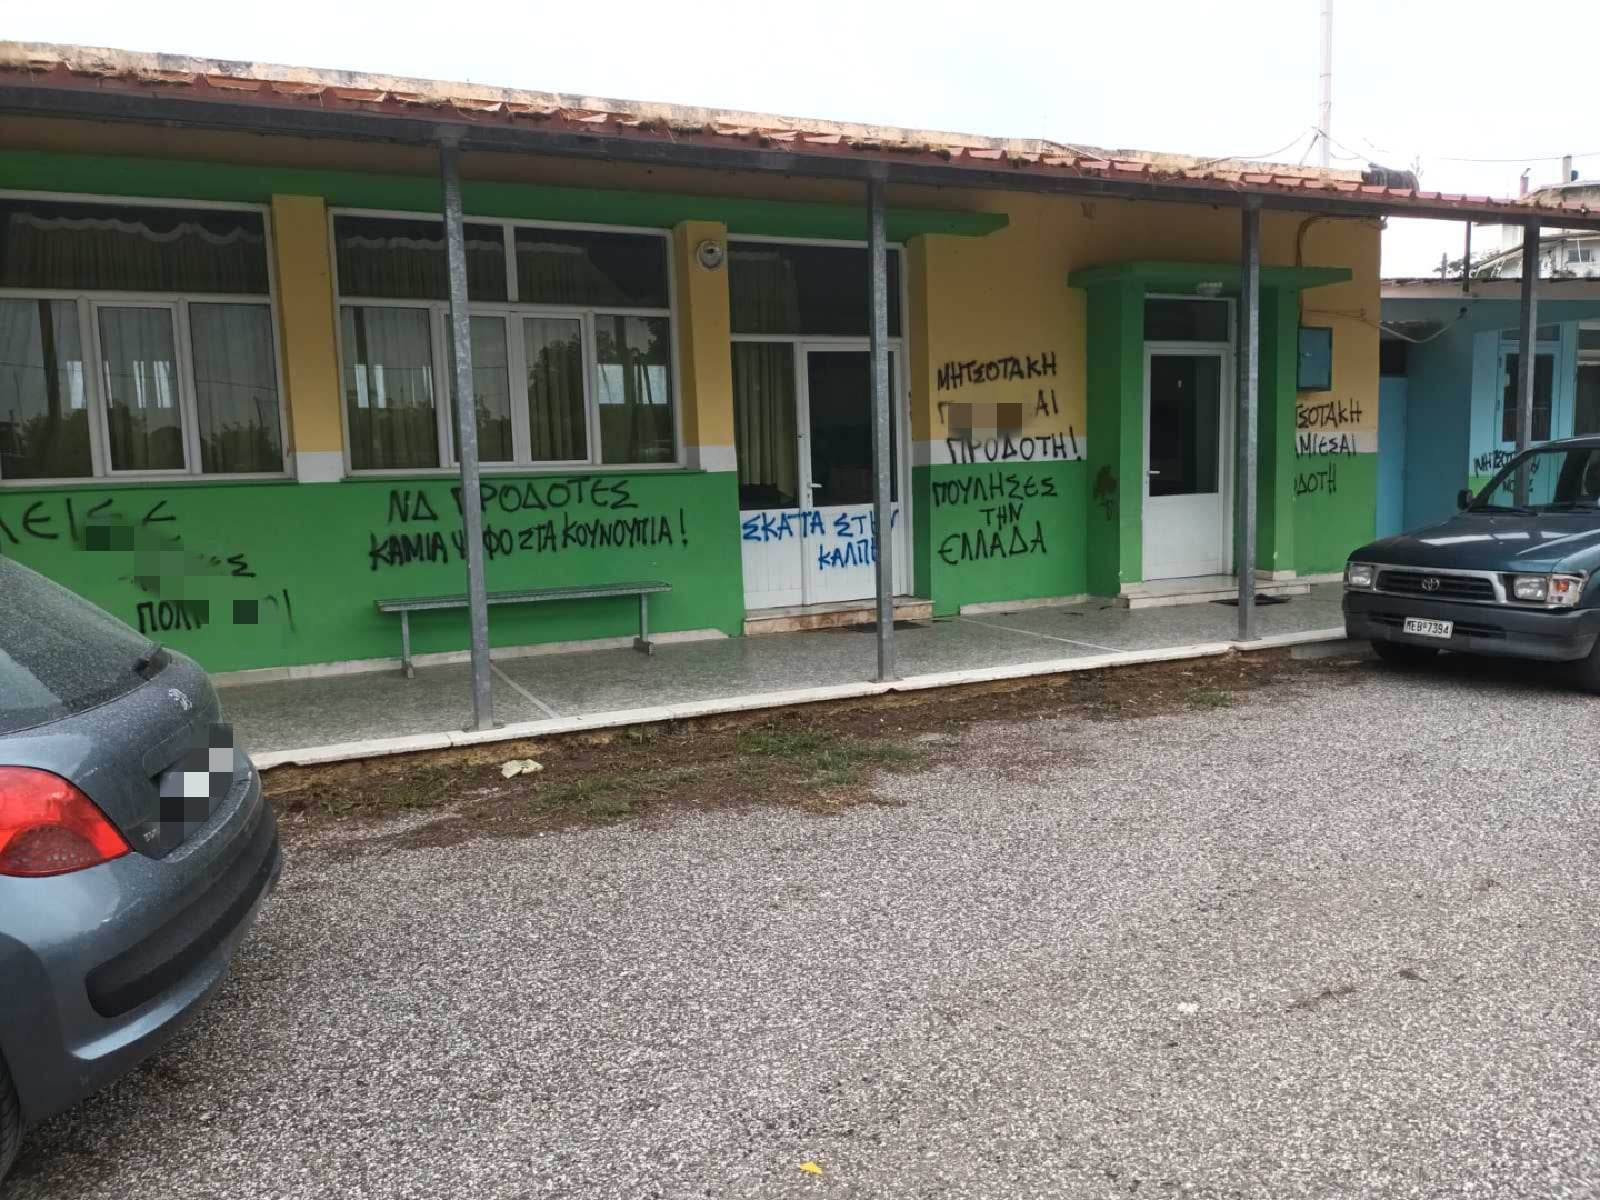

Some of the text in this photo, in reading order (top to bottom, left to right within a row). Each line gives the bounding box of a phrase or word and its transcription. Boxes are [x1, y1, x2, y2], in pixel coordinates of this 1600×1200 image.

[937, 352, 1057, 391] ΜΗΤΣΟΤΑΚΗ
[932, 470, 1058, 507] ΠΟΥΛΗΣΕΣ
[388, 490, 438, 522] ΝΔ
[979, 502, 1024, 531] ΤΗΝ
[742, 510, 825, 542] ΣΚΑΤΑ
[937, 520, 1047, 565] ΕΛΛΑΔΑ
